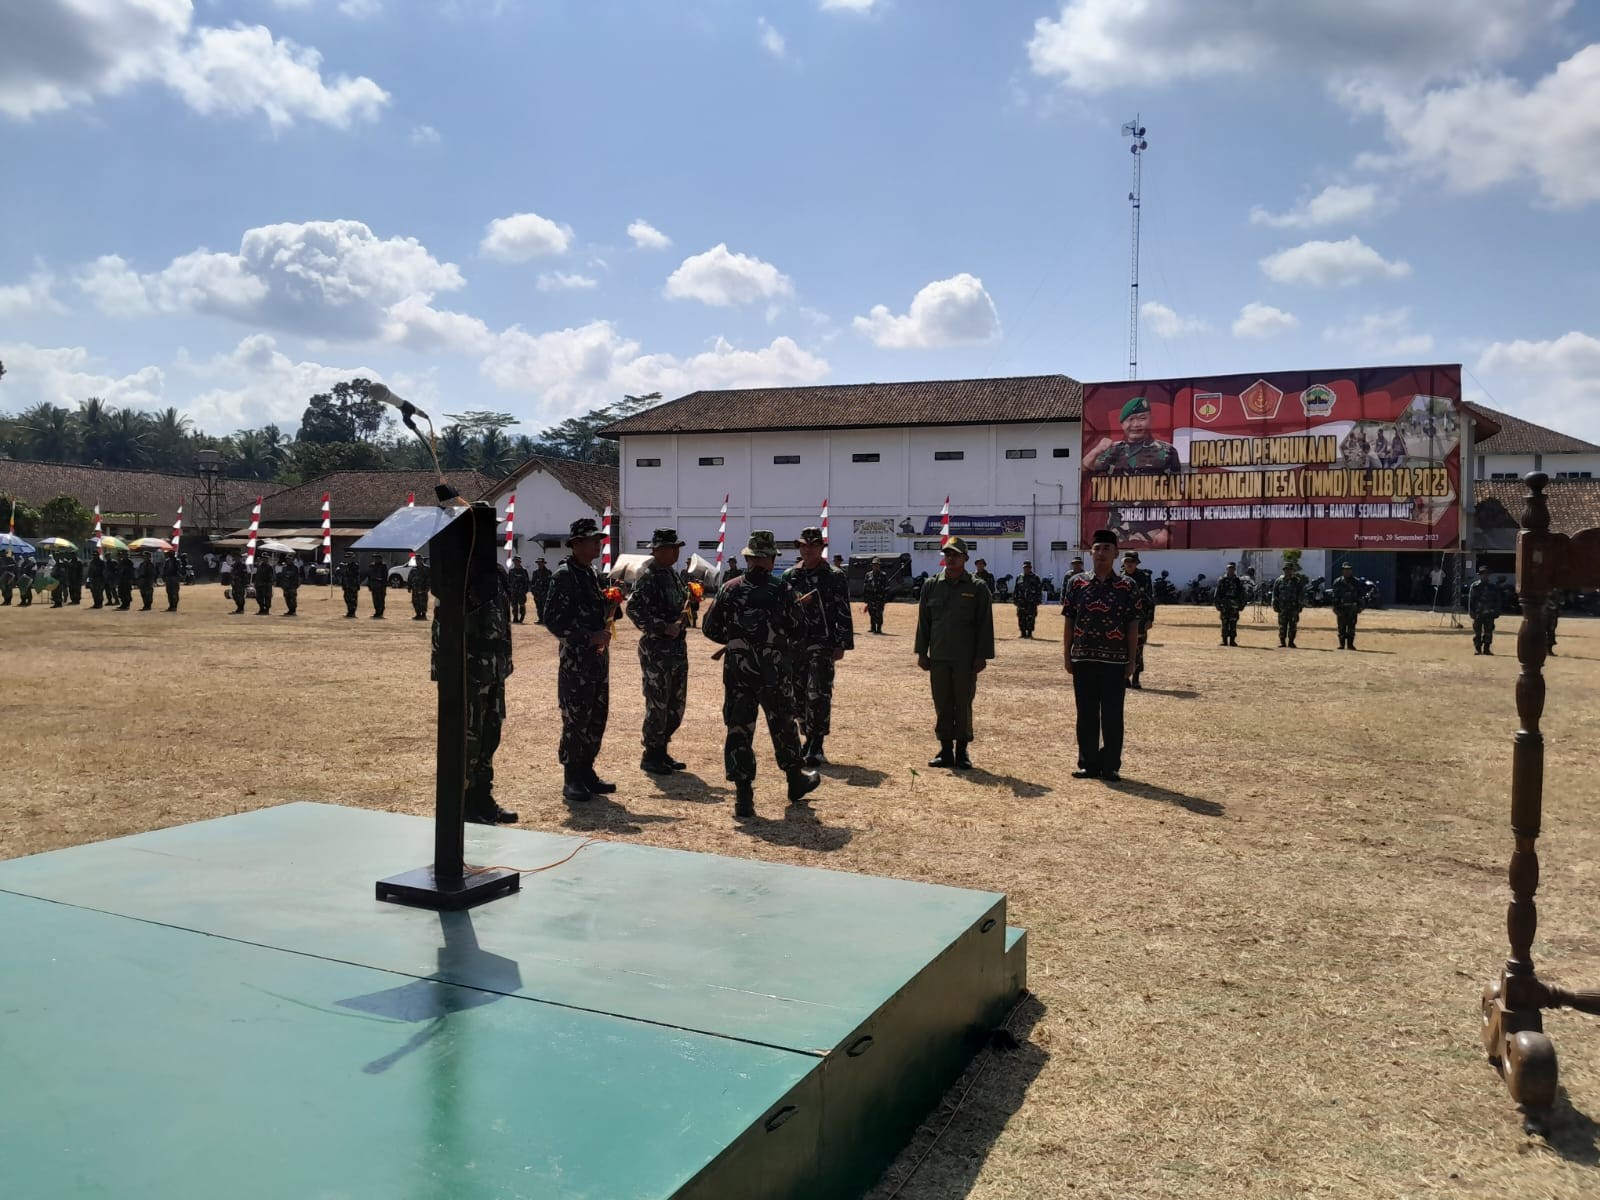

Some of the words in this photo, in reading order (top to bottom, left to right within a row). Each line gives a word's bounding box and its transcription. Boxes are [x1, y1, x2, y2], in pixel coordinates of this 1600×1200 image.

[1192, 441, 1250, 467] UPACARA
[1252, 436, 1337, 465] PEMBUKAAN
[1091, 476, 1109, 502] TNI
[1112, 474, 1182, 500] MANUNGGAL
[1184, 471, 1263, 500] MEMBANGUN
[1264, 470, 1297, 498] DESA
[1298, 468, 1348, 497] (TMMD)
[1350, 468, 1394, 497] KE-118
[1395, 468, 1413, 497] TA
[1413, 468, 1449, 497] 2023
[1146, 507, 1168, 521] LINTAS
[1169, 506, 1201, 521] SEKTORAL
[1203, 505, 1251, 520] MEWUJUDKAN
[1252, 504, 1312, 520] KEMANUNGGALAN
[1313, 503, 1325, 518] TNI
[1330, 503, 1356, 518] RAKYAT
[1358, 503, 1390, 518] SEMAKIN
[1394, 534, 1424, 542] September
